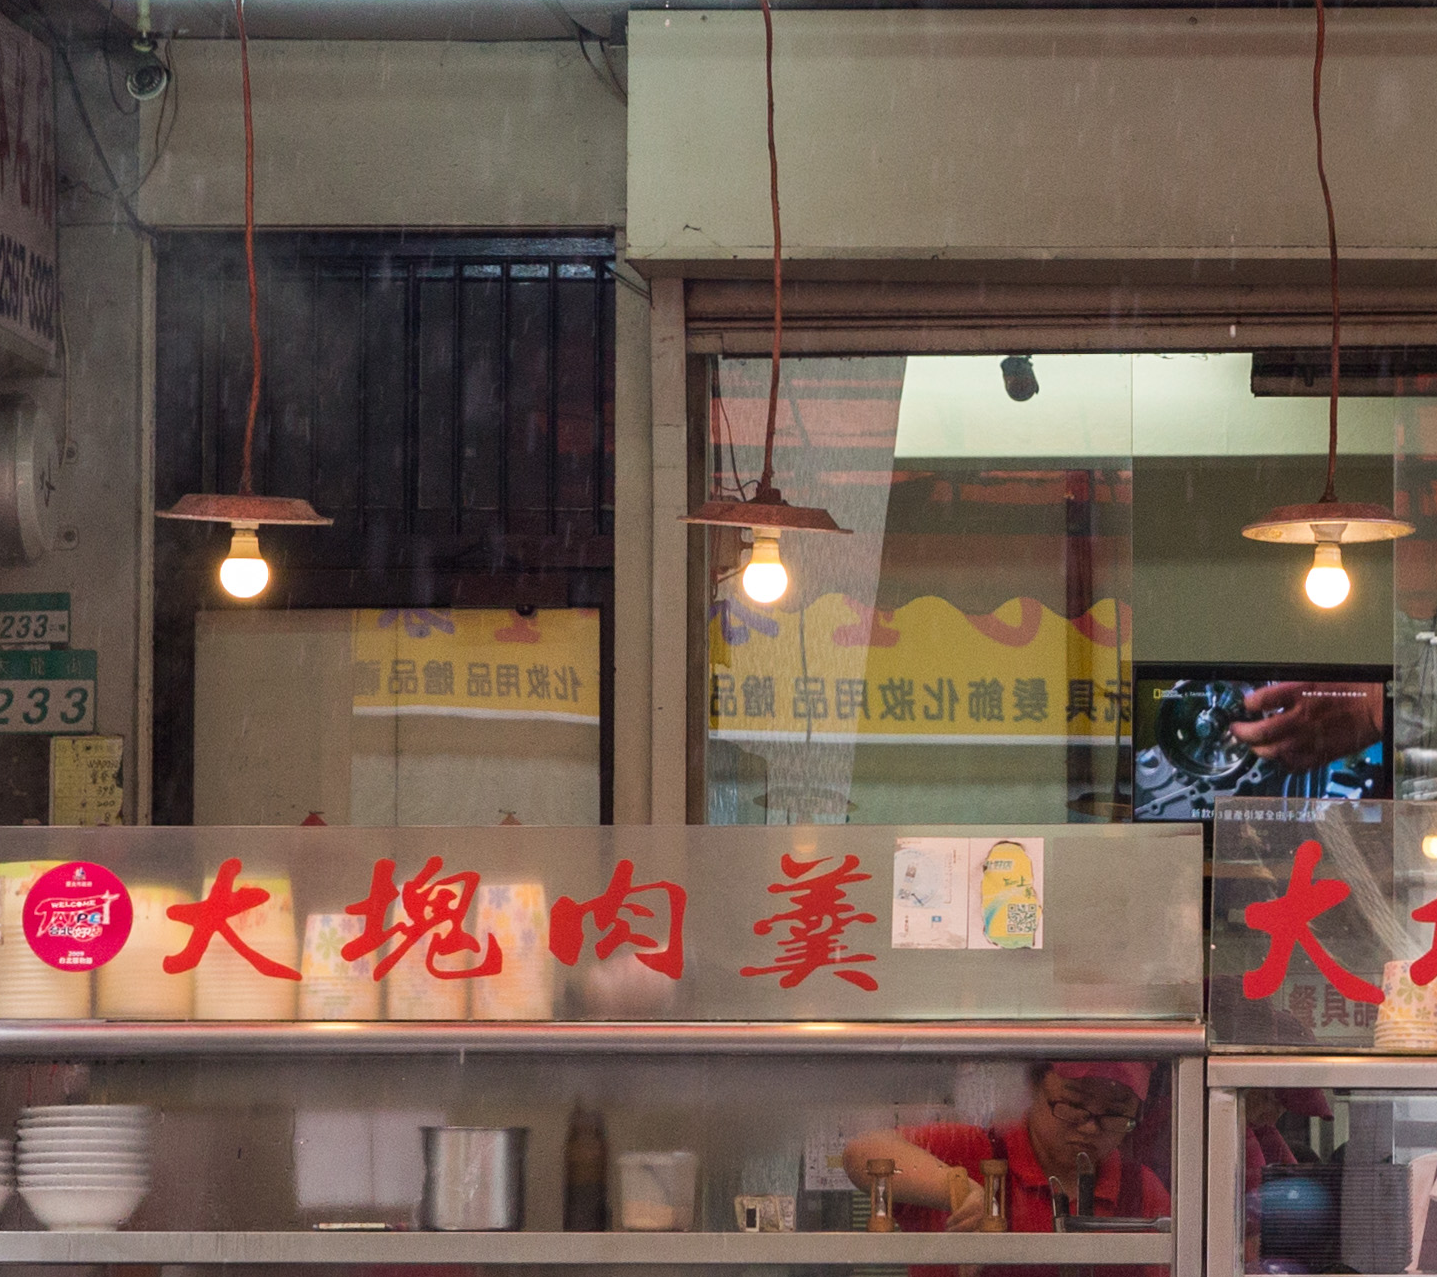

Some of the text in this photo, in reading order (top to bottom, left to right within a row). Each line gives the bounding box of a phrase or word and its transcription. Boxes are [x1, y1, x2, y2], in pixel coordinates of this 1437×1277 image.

[0, 614, 49, 640] 233
[51, 900, 96, 909] WELCOME
[164, 855, 879, 992] 大塊肉羹
